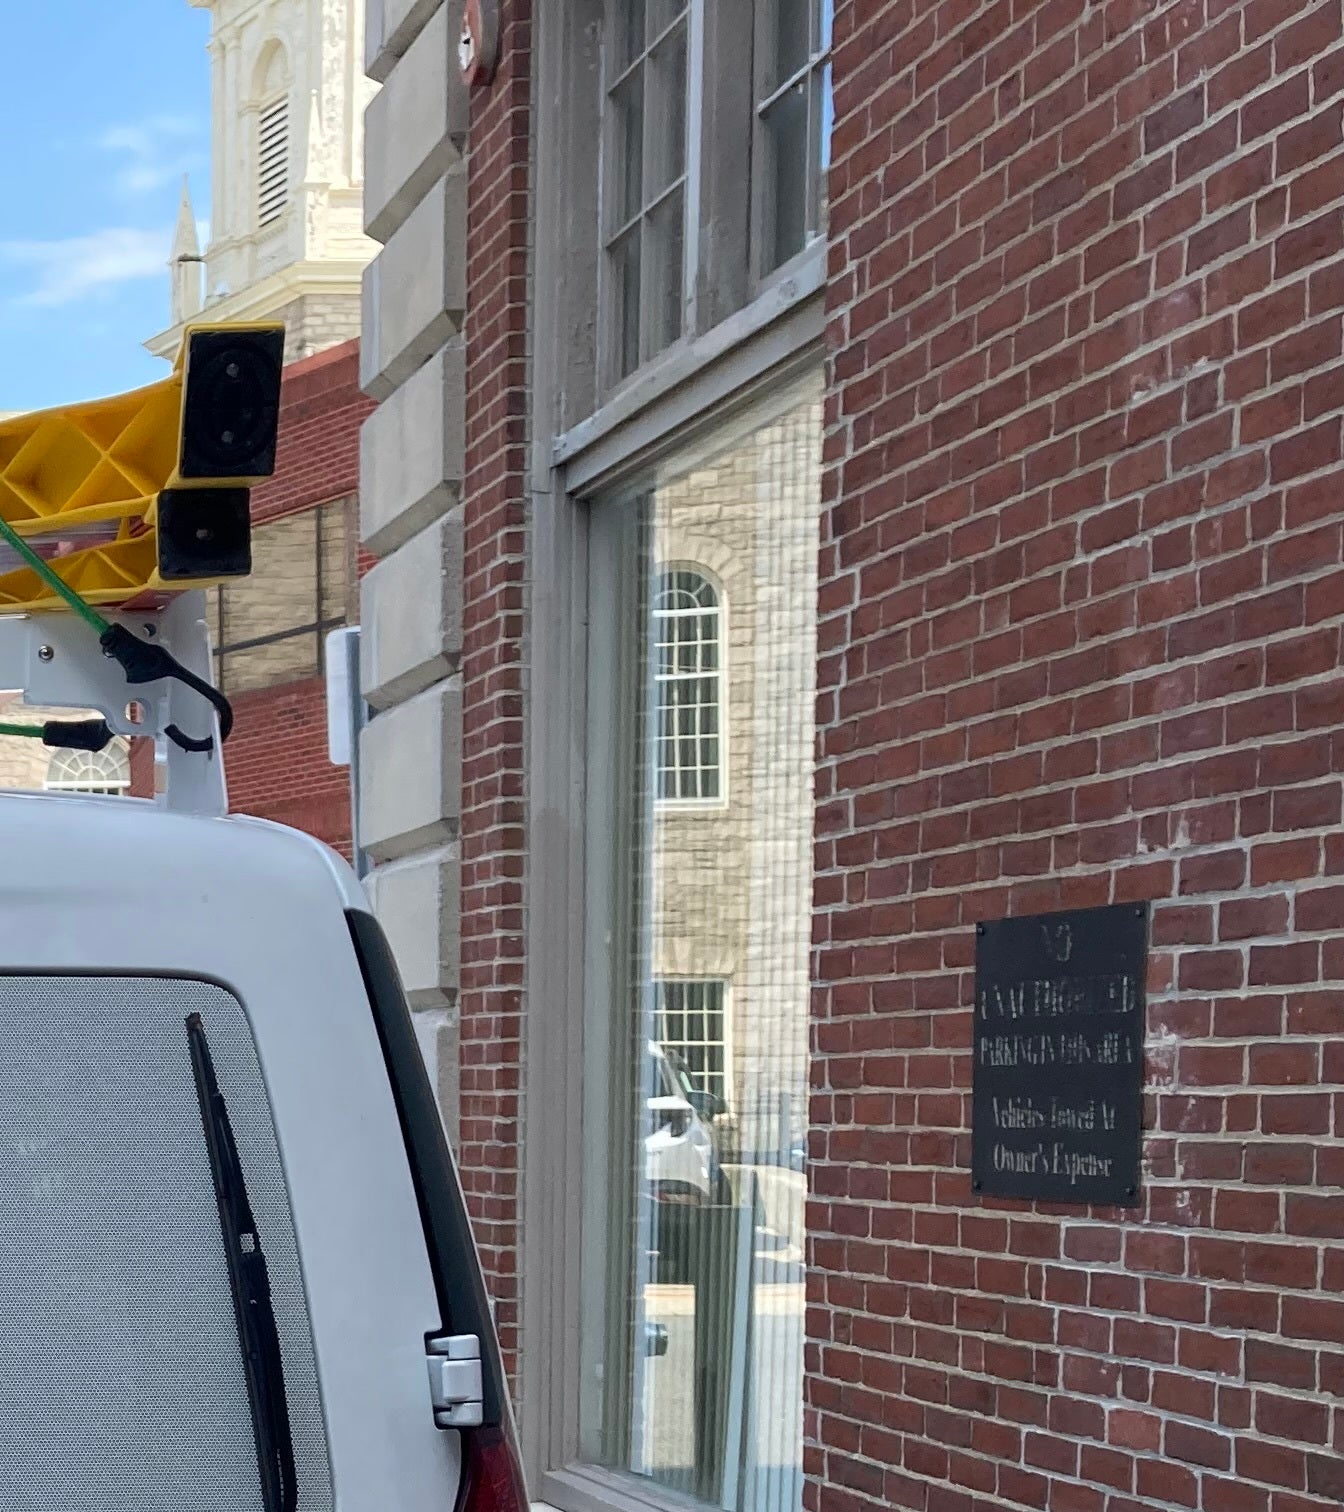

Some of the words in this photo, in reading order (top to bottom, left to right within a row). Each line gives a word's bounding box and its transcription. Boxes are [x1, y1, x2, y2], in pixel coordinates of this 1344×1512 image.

[992, 1096, 1045, 1129] Vehicles
[1049, 1096, 1095, 1130] Towed
[993, 1142, 1049, 1174] Owner's
[1052, 1142, 1113, 1185] Expense
